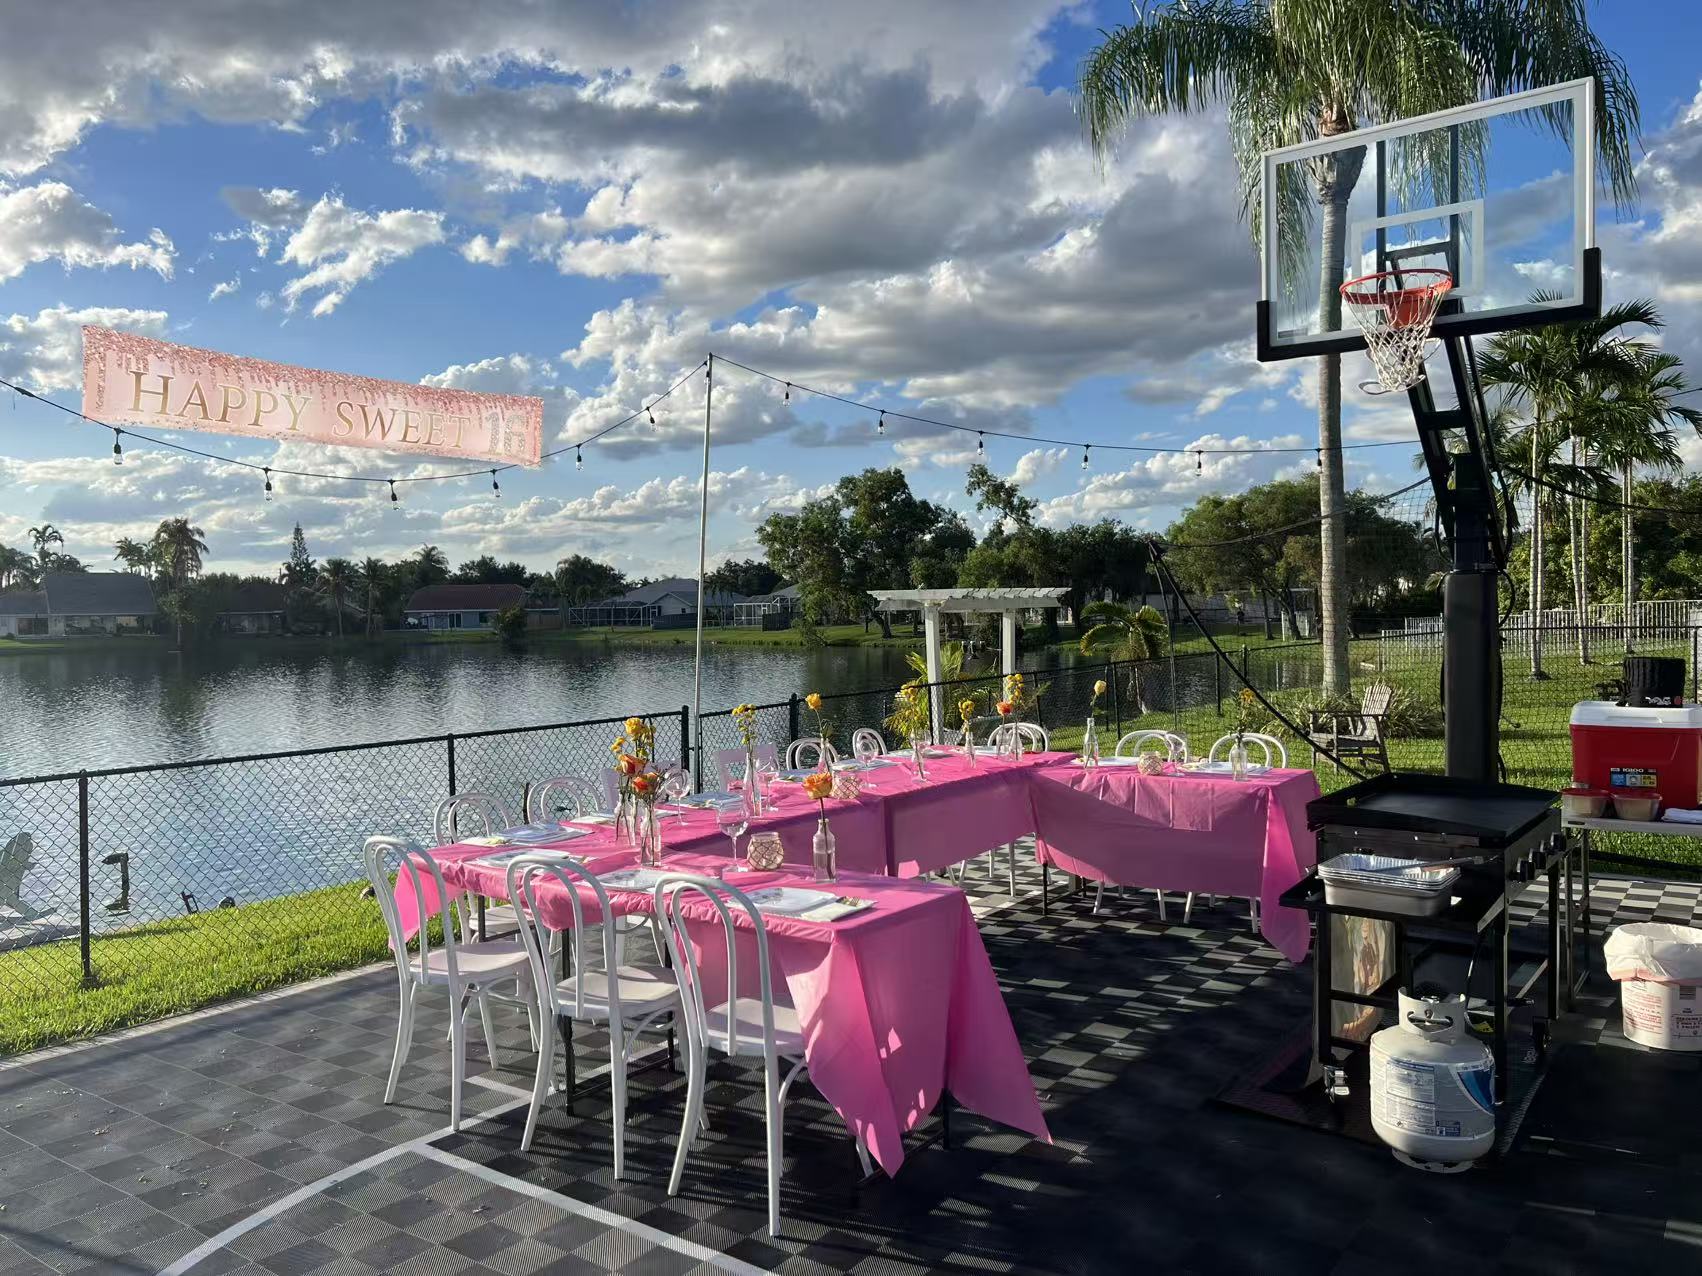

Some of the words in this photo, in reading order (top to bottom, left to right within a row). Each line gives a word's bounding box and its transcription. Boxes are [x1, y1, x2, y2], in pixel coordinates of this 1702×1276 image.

[128, 370, 313, 431] HAPPY
[332, 401, 471, 449] SWEET
[484, 411, 527, 456] 16
